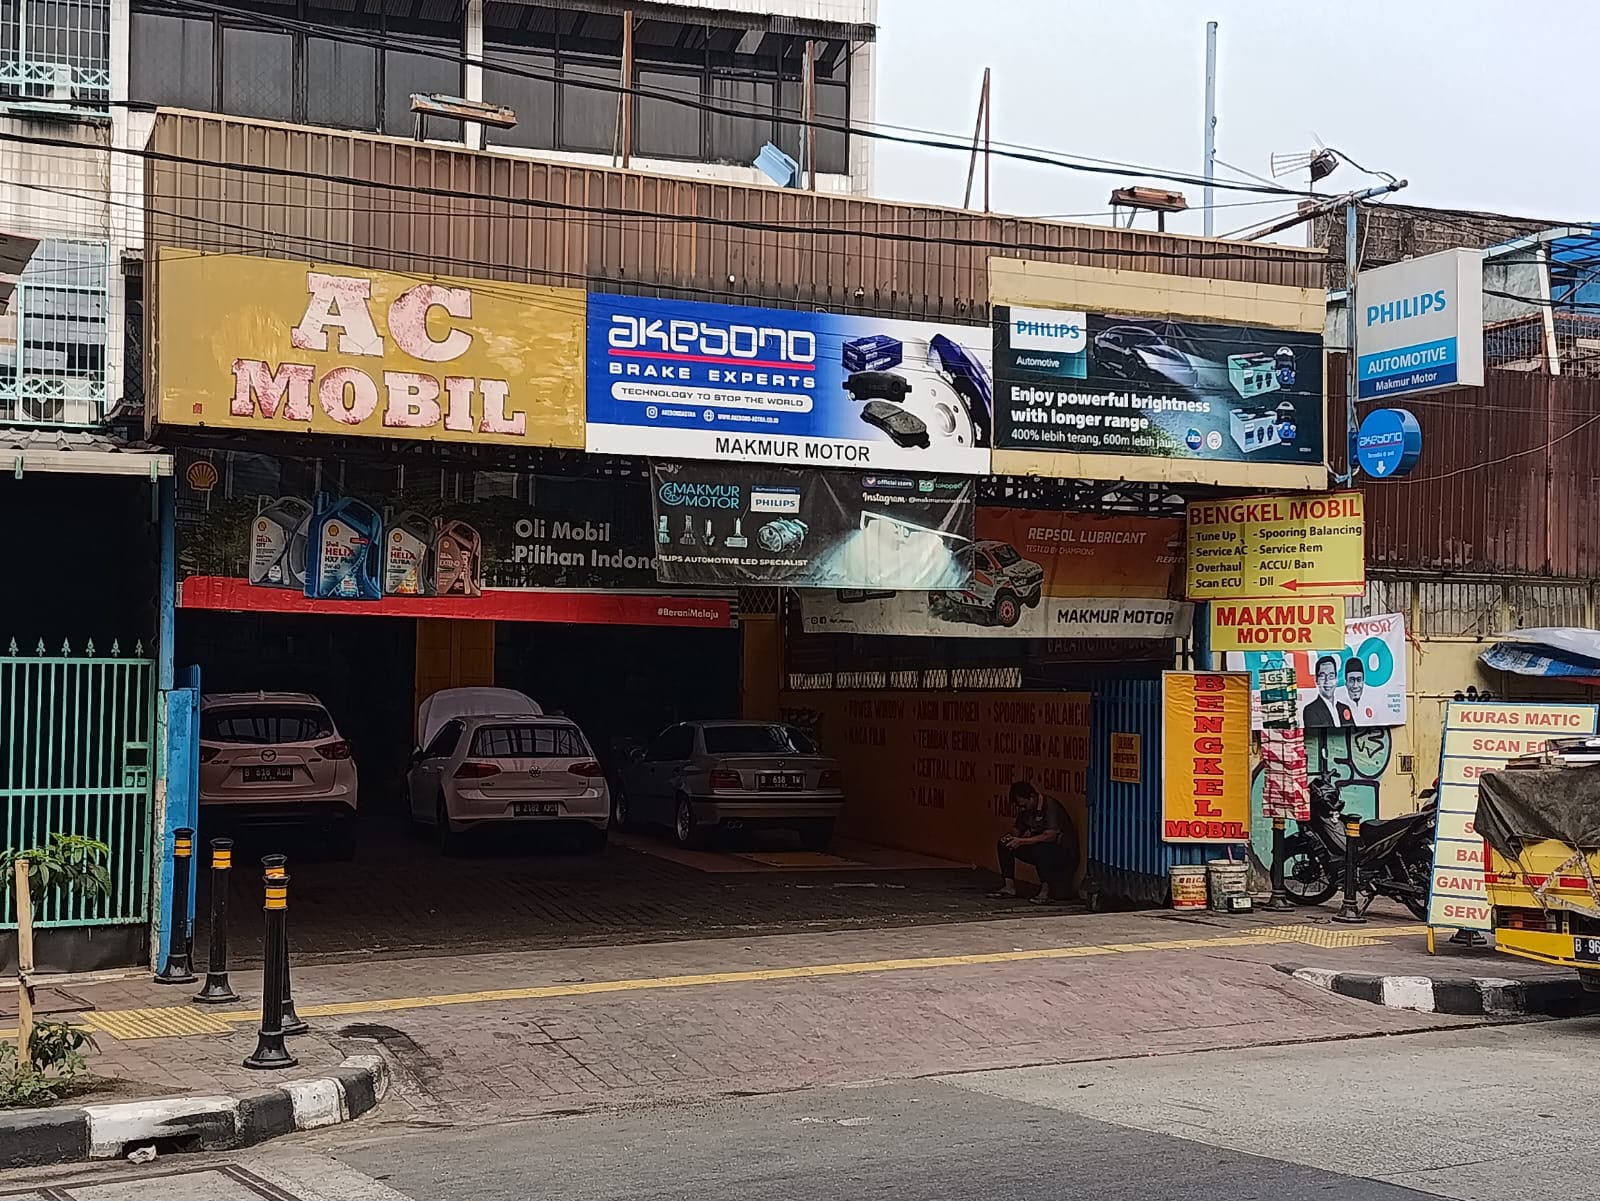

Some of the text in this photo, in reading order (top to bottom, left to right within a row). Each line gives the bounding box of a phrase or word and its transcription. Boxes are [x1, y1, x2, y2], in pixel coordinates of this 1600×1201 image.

[290, 271, 474, 362] AC
[1367, 290, 1446, 327] PHILIPS
[1017, 320, 1079, 339] PHILIPS
[1016, 355, 1060, 368] Automotive
[1367, 346, 1447, 374] AUTOMOTIVE
[609, 362, 815, 389] BRAKE EXPERTS
[1375, 372, 1438, 391] Makmur Motor
[229, 358, 527, 436] MOBIL
[621, 387, 804, 407] TECHNOLOGY TO STOP THE WORLD
[1011, 386, 1210, 413] Enjoy powerful brightness
[1011, 408, 1149, 431] with longer range
[1011, 428, 1039, 441] 400%
[1042, 430, 1065, 442] lebih
[1103, 434, 1130, 445] 600m
[1132, 435, 1154, 447] lebih
[716, 437, 870, 462] MAKMUR MOTOR
[672, 482, 740, 498] MAKMUR
[684, 495, 740, 509] MOTOR
[755, 498, 796, 507] PHILIPS
[1189, 499, 1361, 526] BENGKEL MOBIL
[515, 519, 611, 542] Oli Mobil
[1028, 527, 1148, 545] REPSOL LUBRICANT
[1196, 531, 1236, 542] Tune Up
[1259, 525, 1362, 540] Spooring Balancing
[325, 548, 355, 557] HELIX
[514, 544, 585, 567] Pilihan
[1196, 545, 1248, 557] Service AC
[1259, 543, 1323, 554] Service Rem
[684, 556, 739, 564] AUTOMOTIVE
[1196, 562, 1242, 573] Overhaul
[1294, 559, 1315, 569] Ban
[1196, 577, 1242, 588] Scan ECU
[1057, 609, 1174, 625] MAKMUR MOTOR
[1216, 605, 1336, 627] MAKMUR
[1237, 627, 1312, 644] MOTOR
[993, 702, 1036, 724] SPOORING
[1460, 711, 1581, 727] KURAS MATIC
[993, 731, 1017, 755] ACCU
[1023, 733, 1041, 756] BAN
[1048, 736, 1060, 758] AC
[1193, 674, 1225, 817] BENGKEL
[1472, 739, 1520, 752] SCAN
[1165, 820, 1249, 839] MOBIL
[1443, 905, 1490, 920] SERV
[1575, 939, 1581, 952] B
